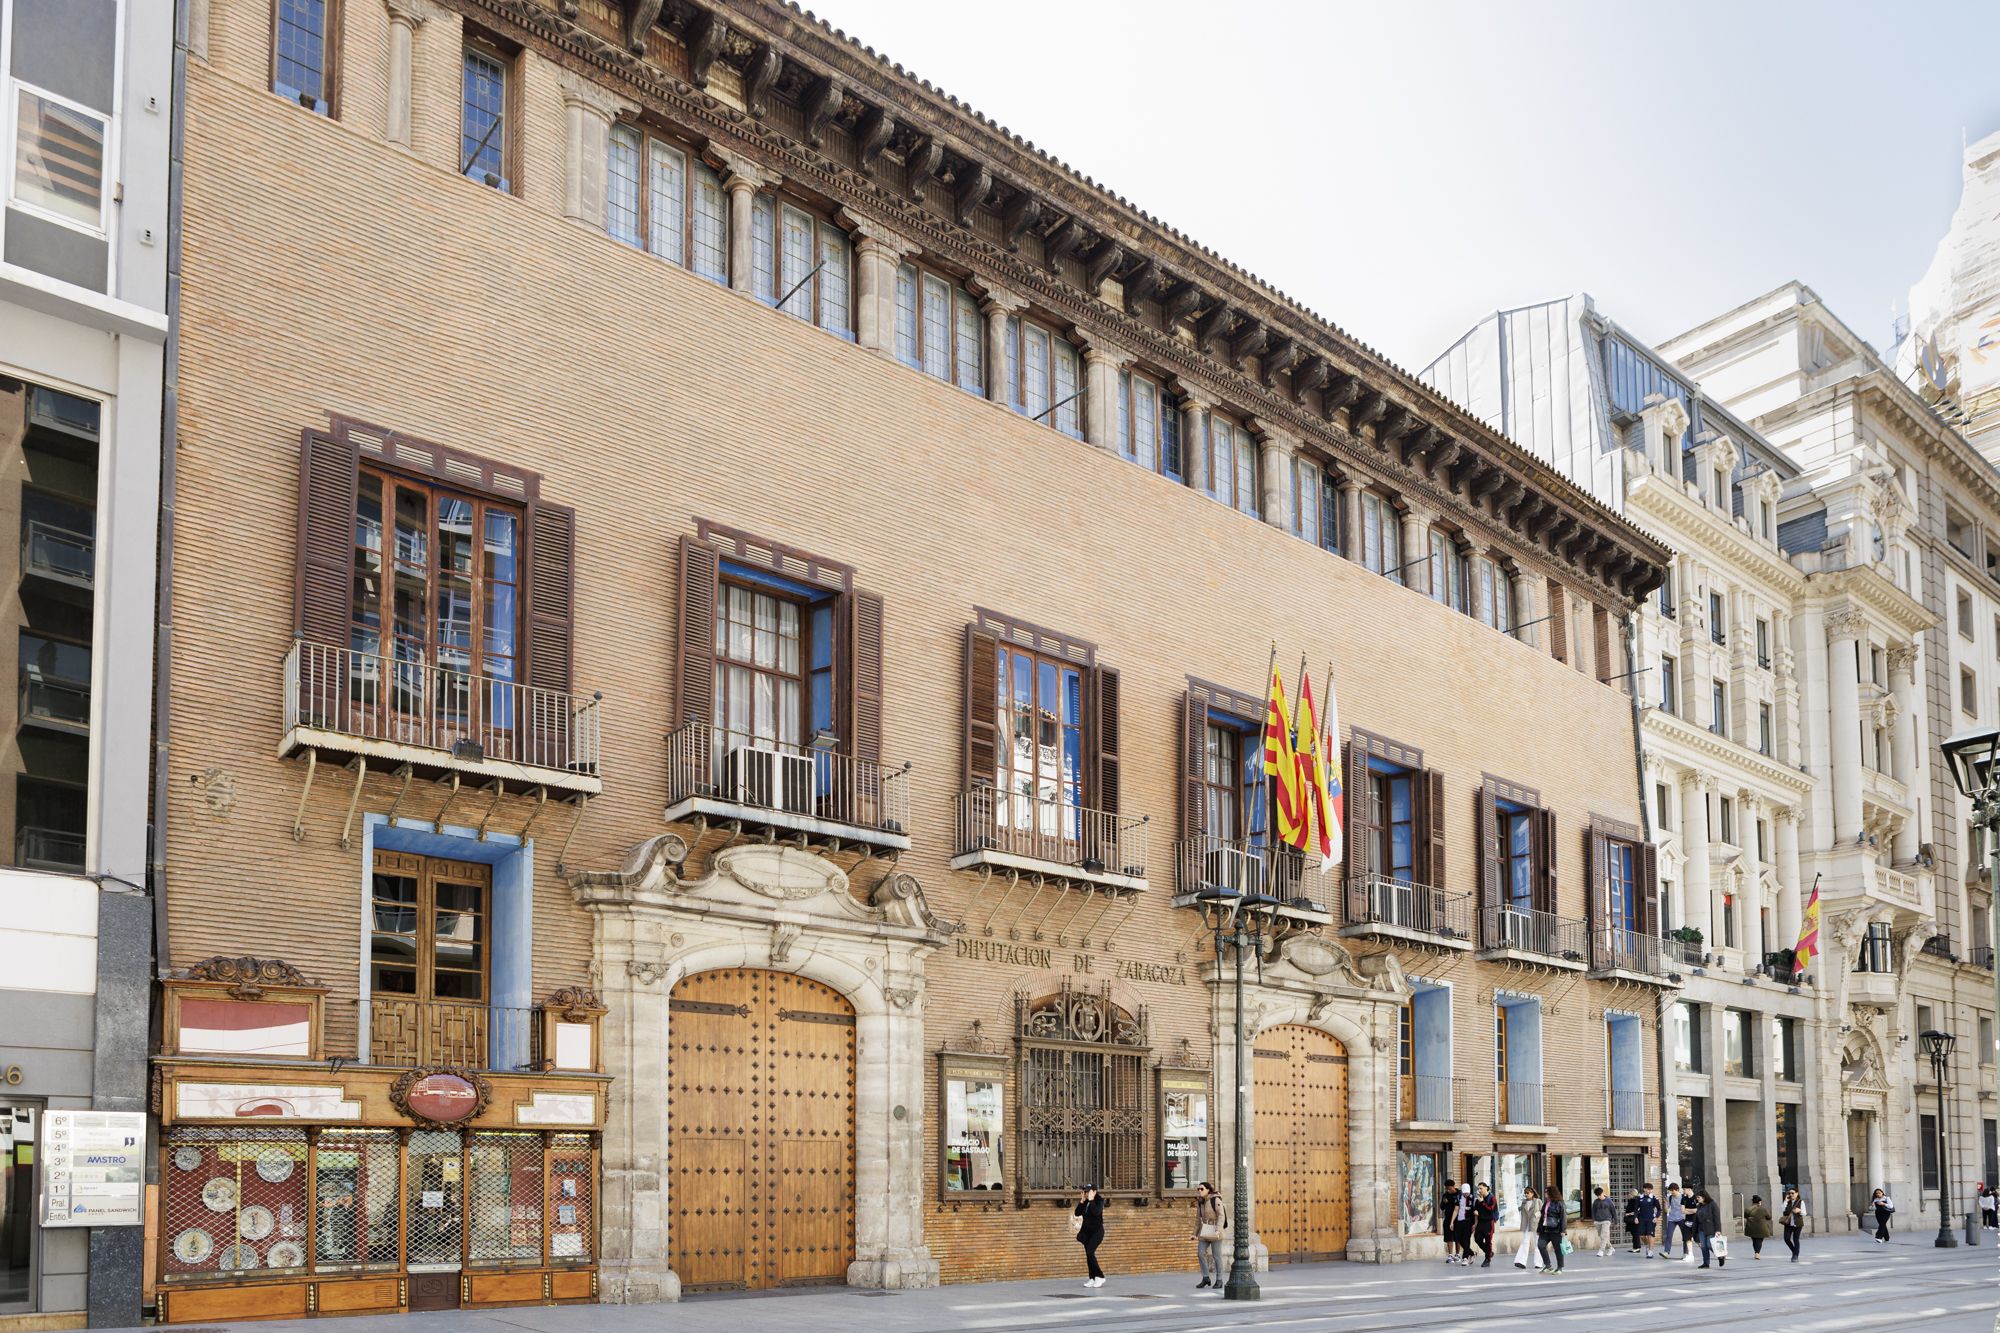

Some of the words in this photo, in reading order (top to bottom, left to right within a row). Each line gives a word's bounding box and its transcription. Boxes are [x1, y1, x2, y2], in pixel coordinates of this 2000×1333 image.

[957, 938, 1051, 968] DIPUTACION
[1074, 953, 1095, 974] DE
[1116, 958, 1187, 986] ZARAGOZA
[87, 1156, 126, 1164] AMSTRO
